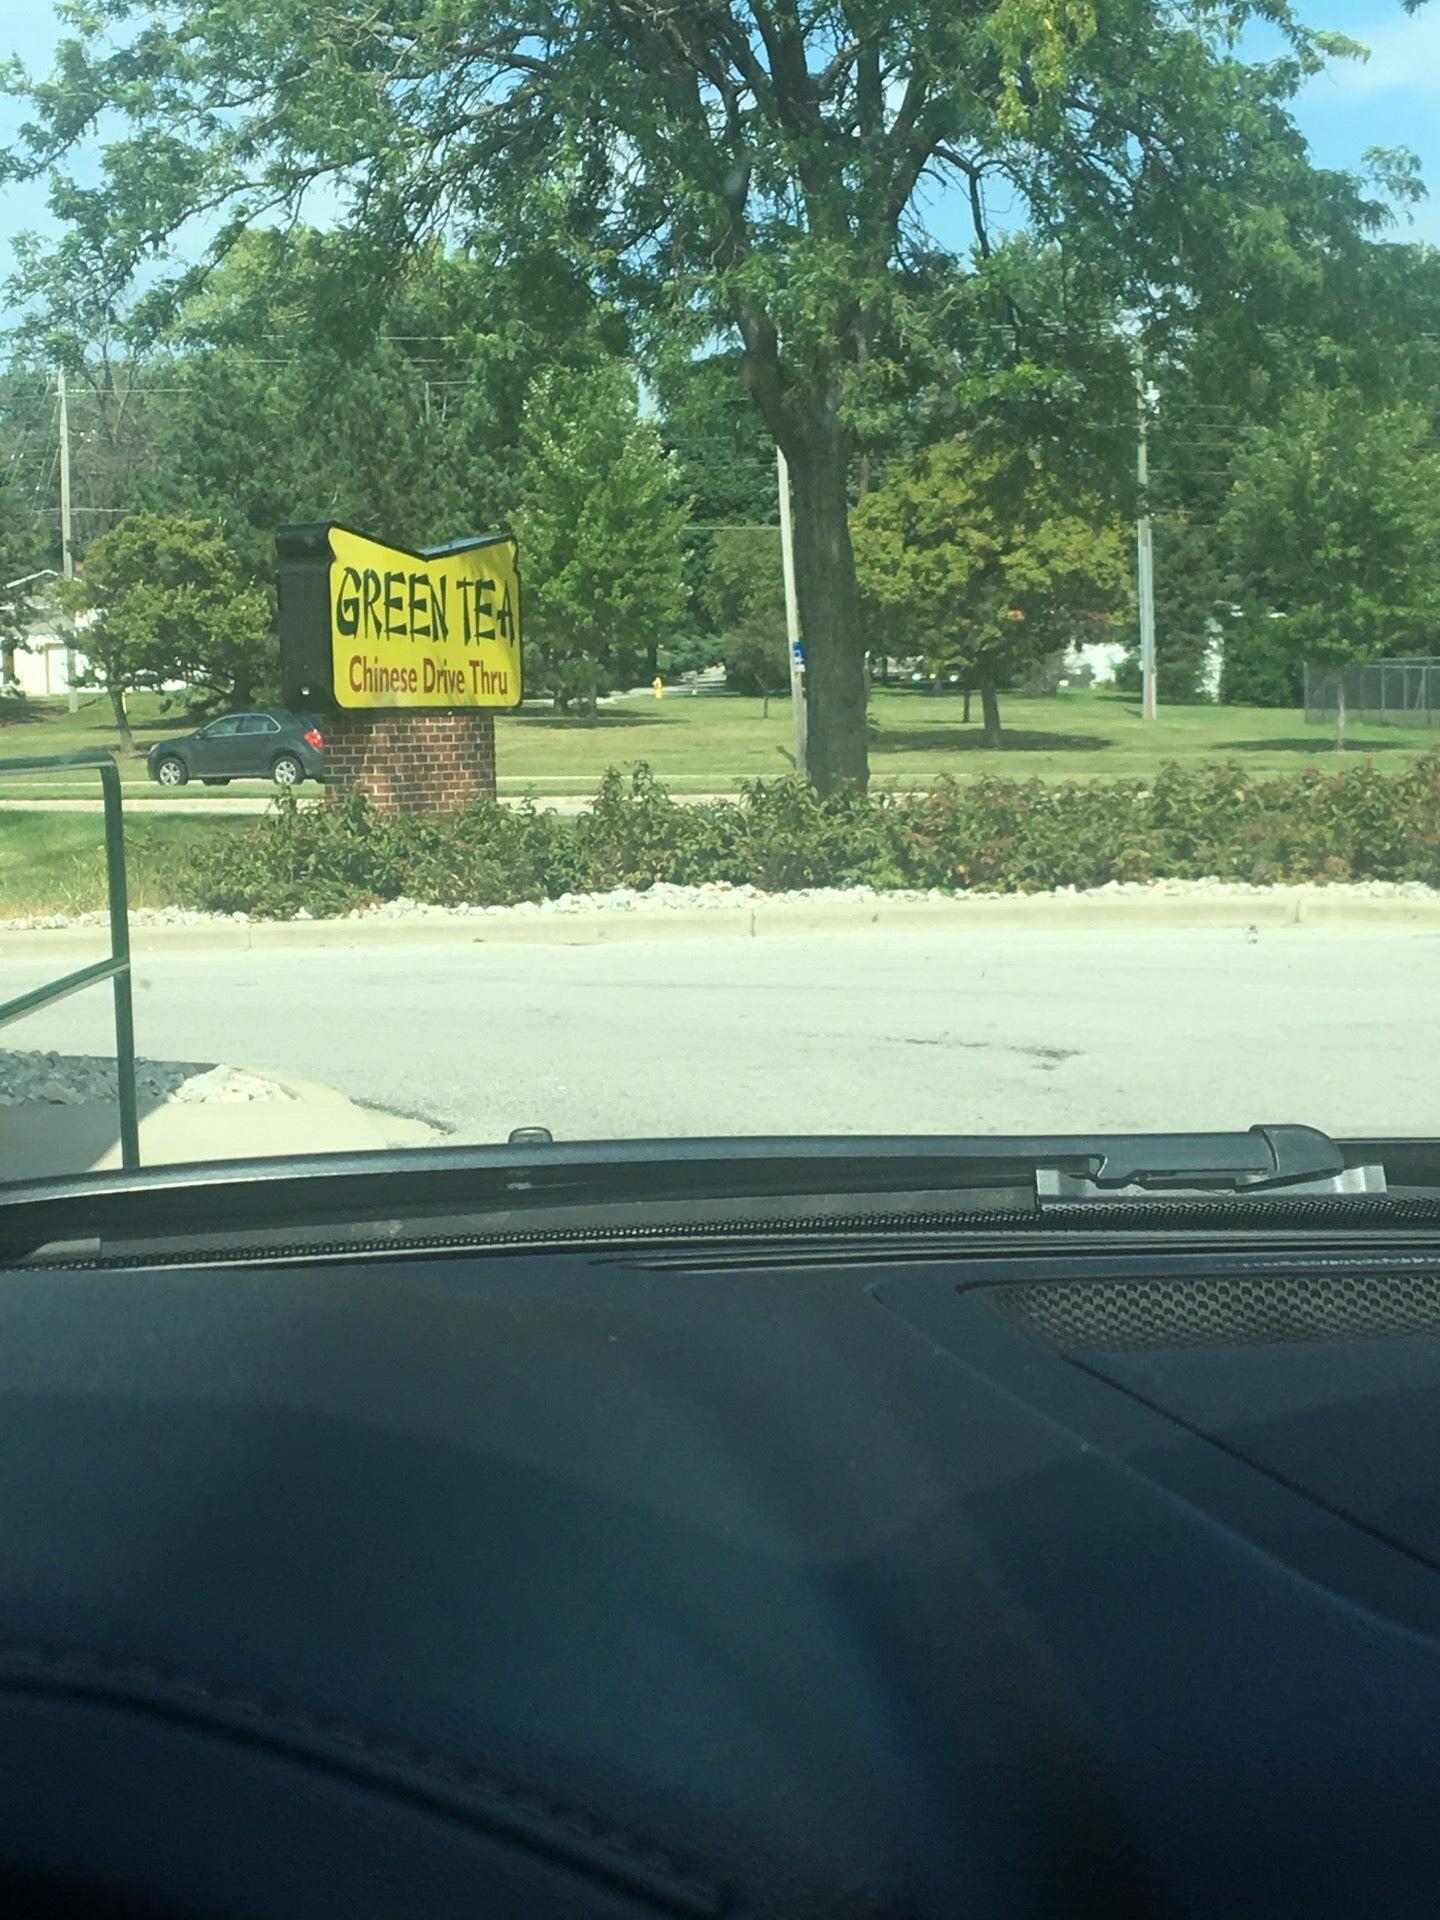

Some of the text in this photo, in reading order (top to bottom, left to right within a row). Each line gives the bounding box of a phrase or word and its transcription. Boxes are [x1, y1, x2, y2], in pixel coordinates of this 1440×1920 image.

[336, 566, 515, 648] GREEN TEA
[349, 655, 508, 695] Chinese Drive Thru
